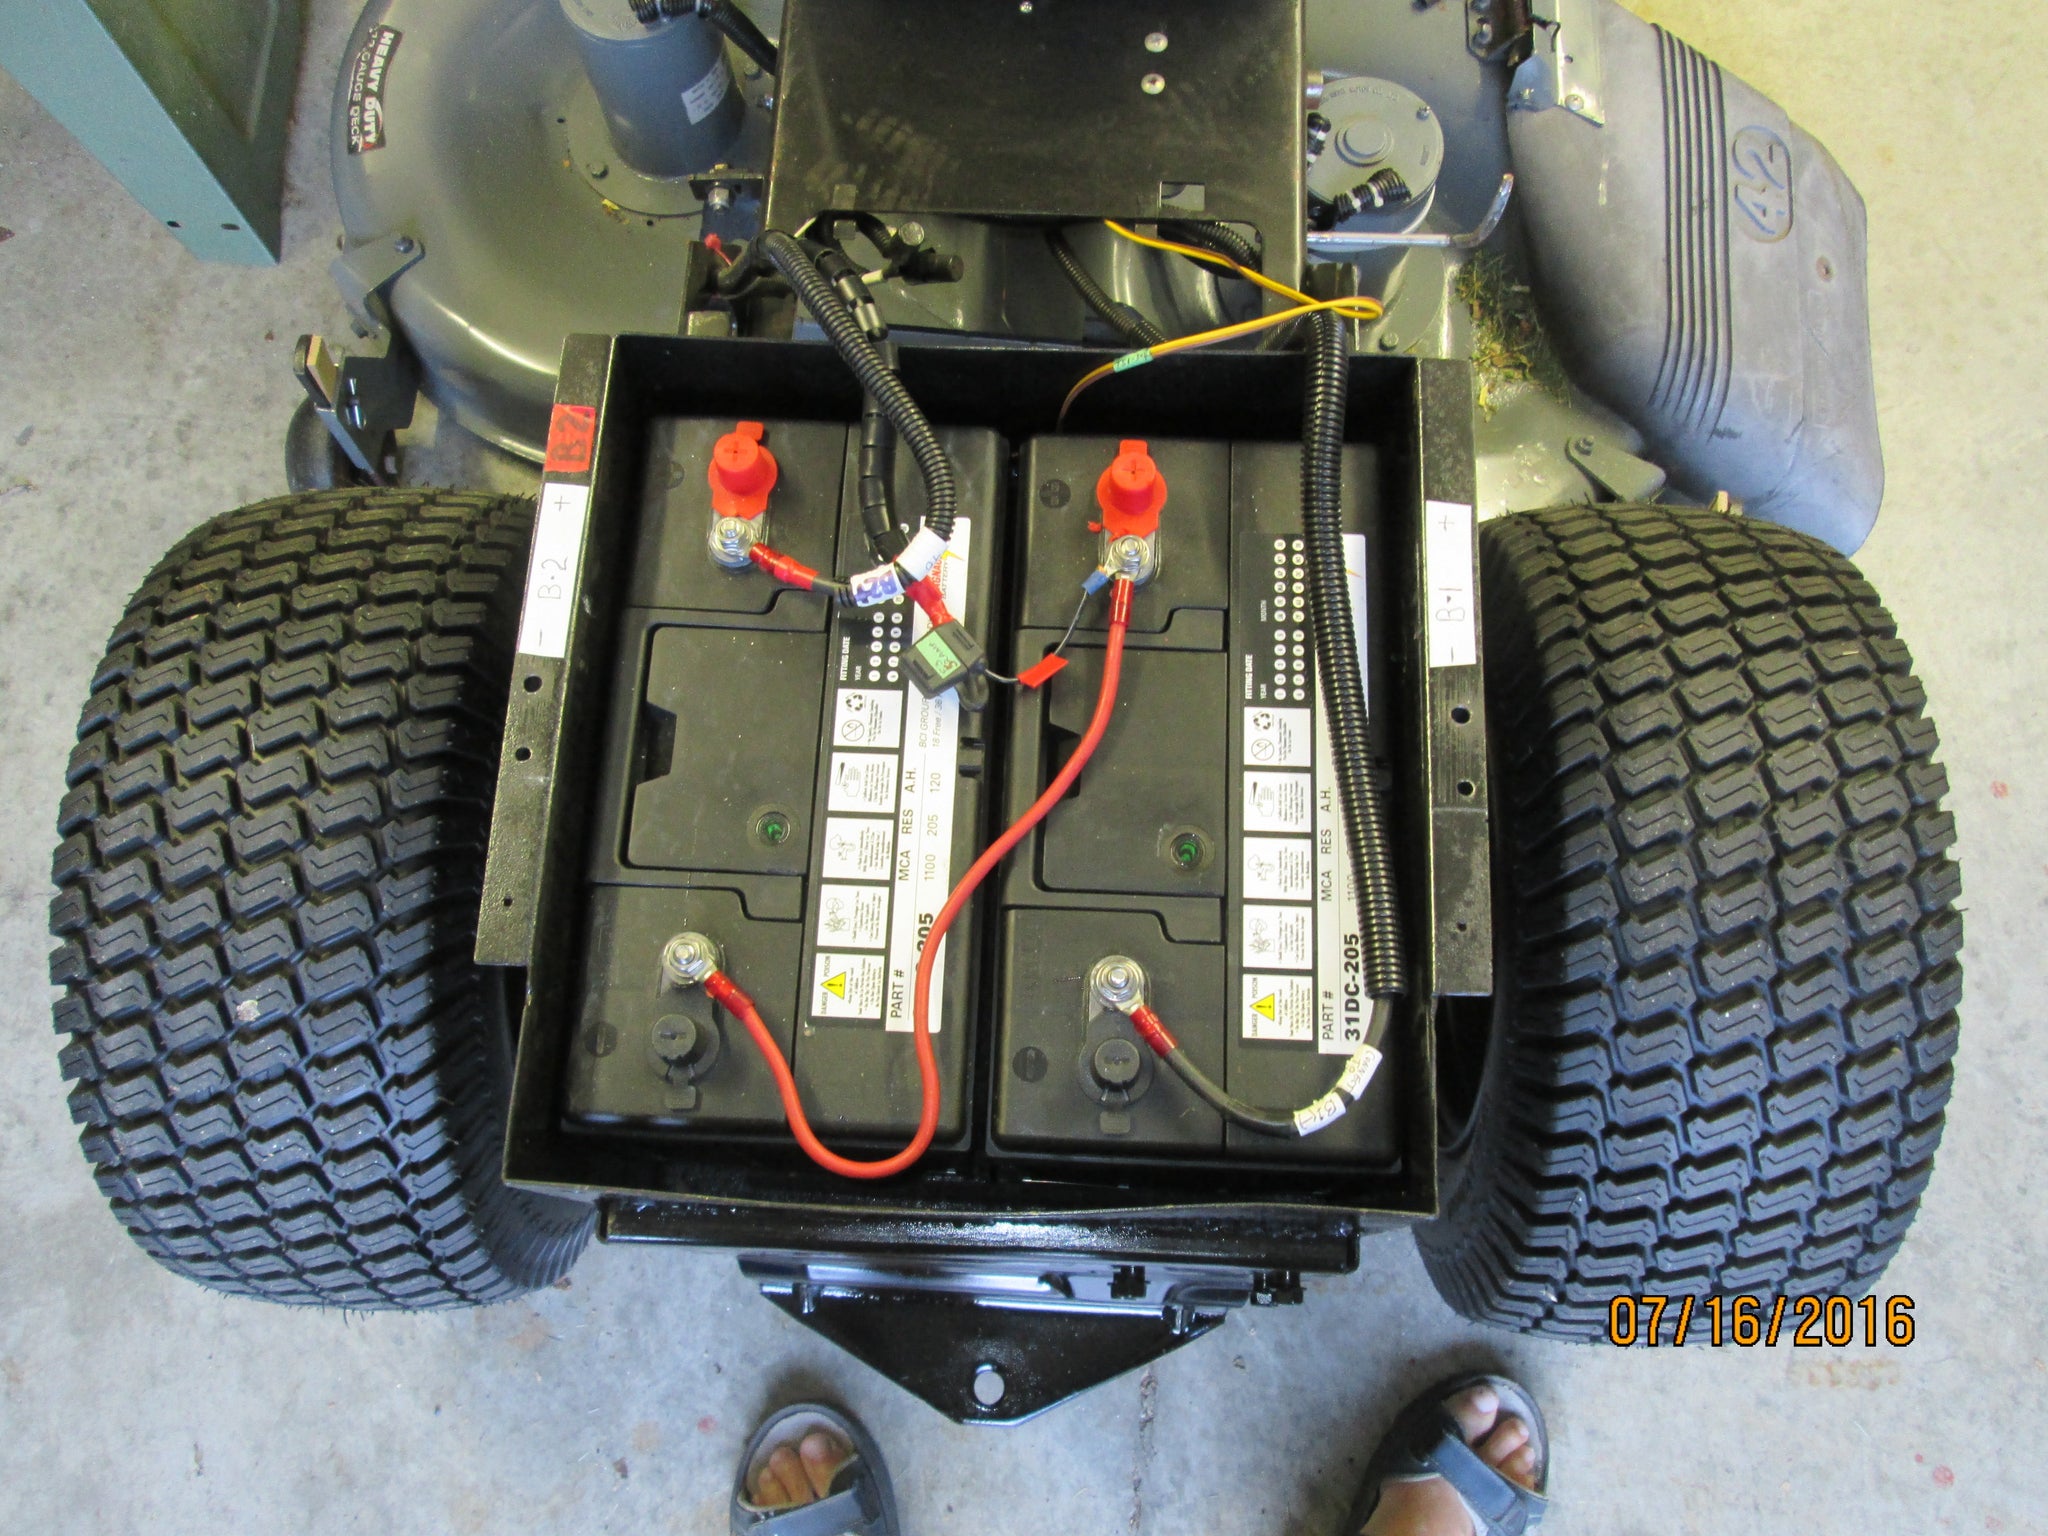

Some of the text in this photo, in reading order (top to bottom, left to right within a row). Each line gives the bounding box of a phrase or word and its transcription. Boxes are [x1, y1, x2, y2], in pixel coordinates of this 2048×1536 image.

[367, 31, 395, 92] HEAVY
[363, 97, 377, 142] DUTY
[1731, 142, 1787, 234] 42
[840, 636, 850, 681] FITTING DATE
[923, 772, 941, 881] 1100 205 120
[890, 767, 916, 1018] PART # MCA RES A.H.
[1320, 787, 1334, 1040] PART # MCA RES A.H.
[823, 955, 831, 977] POISON
[1343, 934, 1360, 1041] 31DC-205
